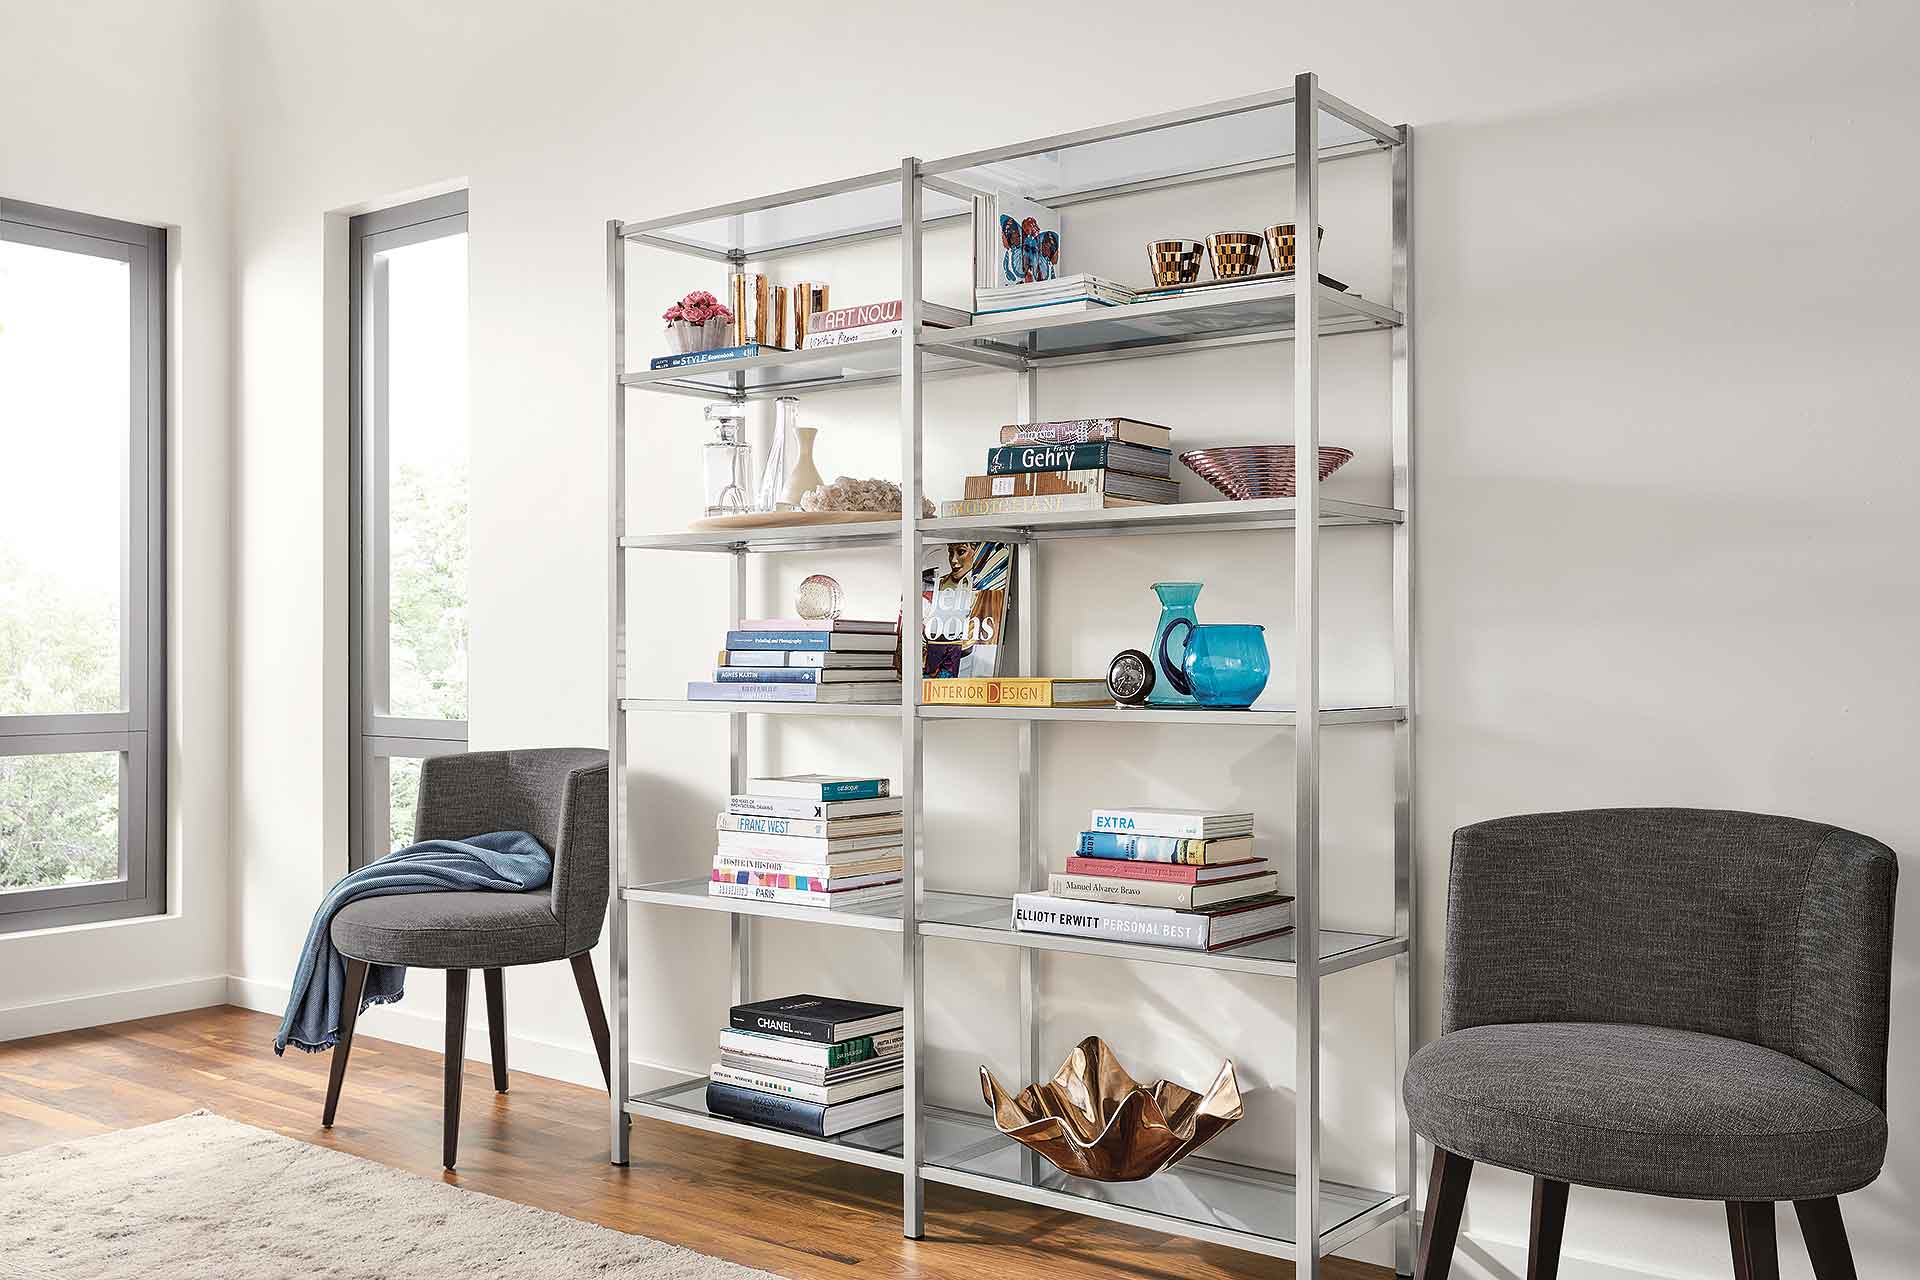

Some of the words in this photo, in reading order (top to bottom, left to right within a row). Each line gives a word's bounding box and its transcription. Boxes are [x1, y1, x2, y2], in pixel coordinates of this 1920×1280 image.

[825, 309, 856, 329] ART
[857, 302, 897, 325] NOW
[681, 353, 708, 366] STYLE
[1022, 448, 1075, 471] Gehry
[924, 615, 995, 642] oons
[739, 818, 766, 833] FRANZ
[767, 821, 790, 834] WEST
[1096, 816, 1136, 830] EXTRA
[755, 887, 776, 899] PARIS
[1066, 881, 1092, 891] Manuel
[1092, 883, 1119, 894] Alvarez
[1120, 886, 1141, 895] Bravo
[1016, 909, 1056, 924] ELLIOTT
[1059, 913, 1100, 929] ERWITT
[1103, 919, 1160, 935] PERSONAL
[1162, 924, 1192, 938] BEST
[757, 1017, 794, 1033] CHANEL
